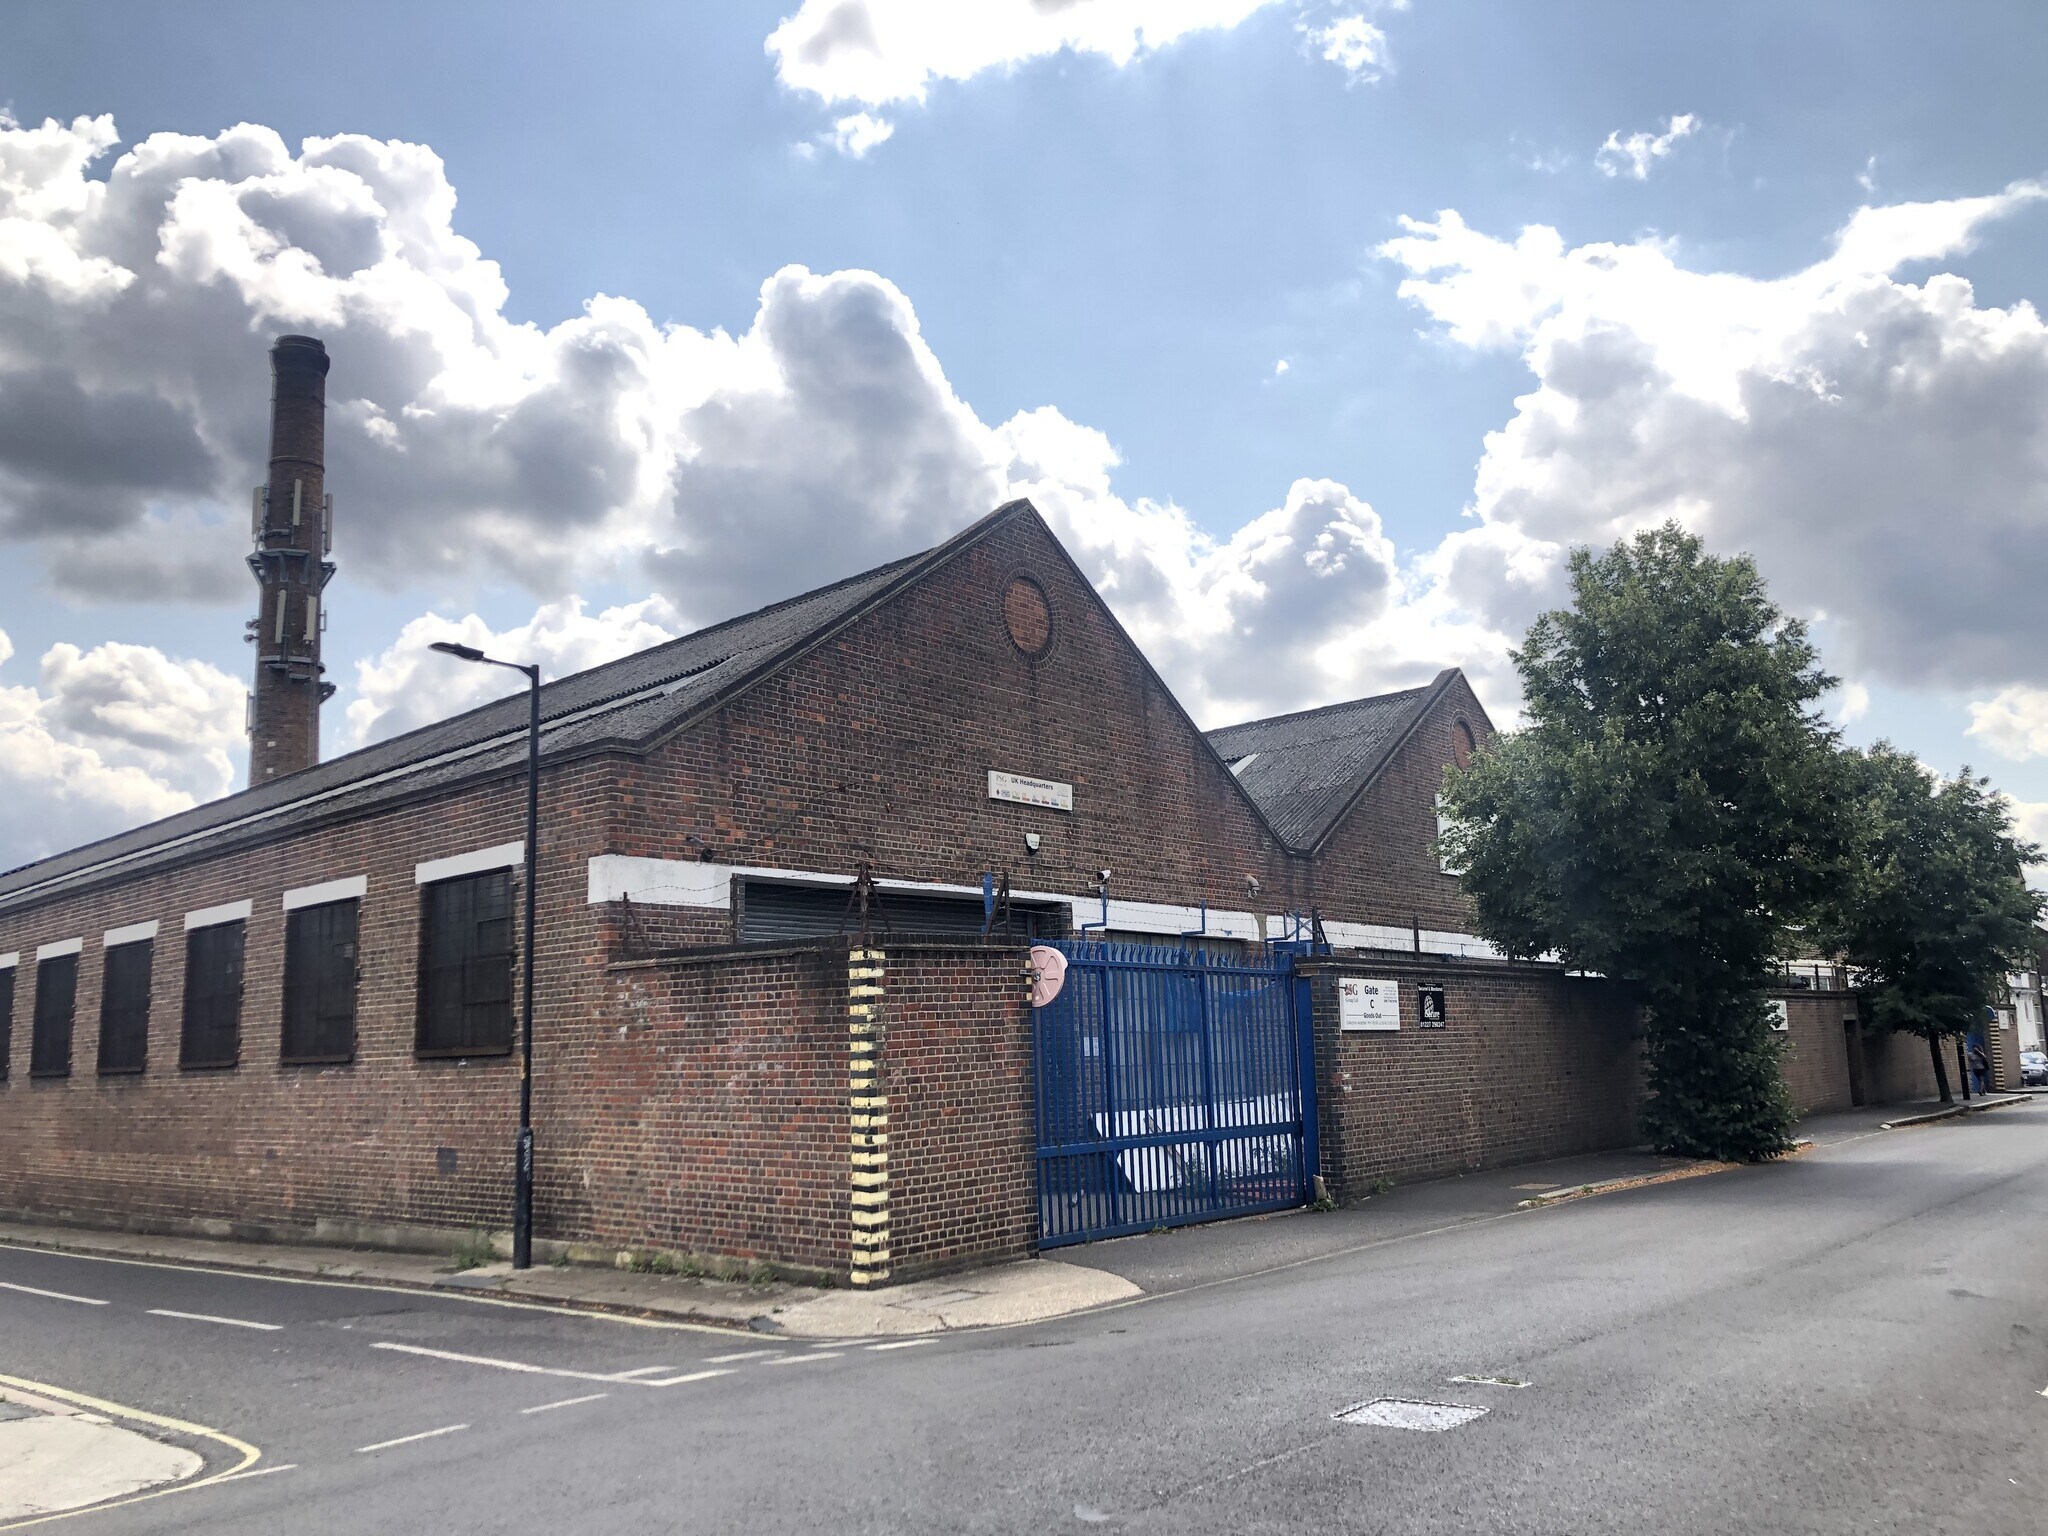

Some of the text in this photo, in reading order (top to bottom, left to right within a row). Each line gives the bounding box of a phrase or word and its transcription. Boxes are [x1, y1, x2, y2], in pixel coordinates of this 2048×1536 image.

[1020, 778, 1053, 790] Headquarters
[1365, 985, 1378, 995] Gate
[1370, 999, 1374, 1009] C
